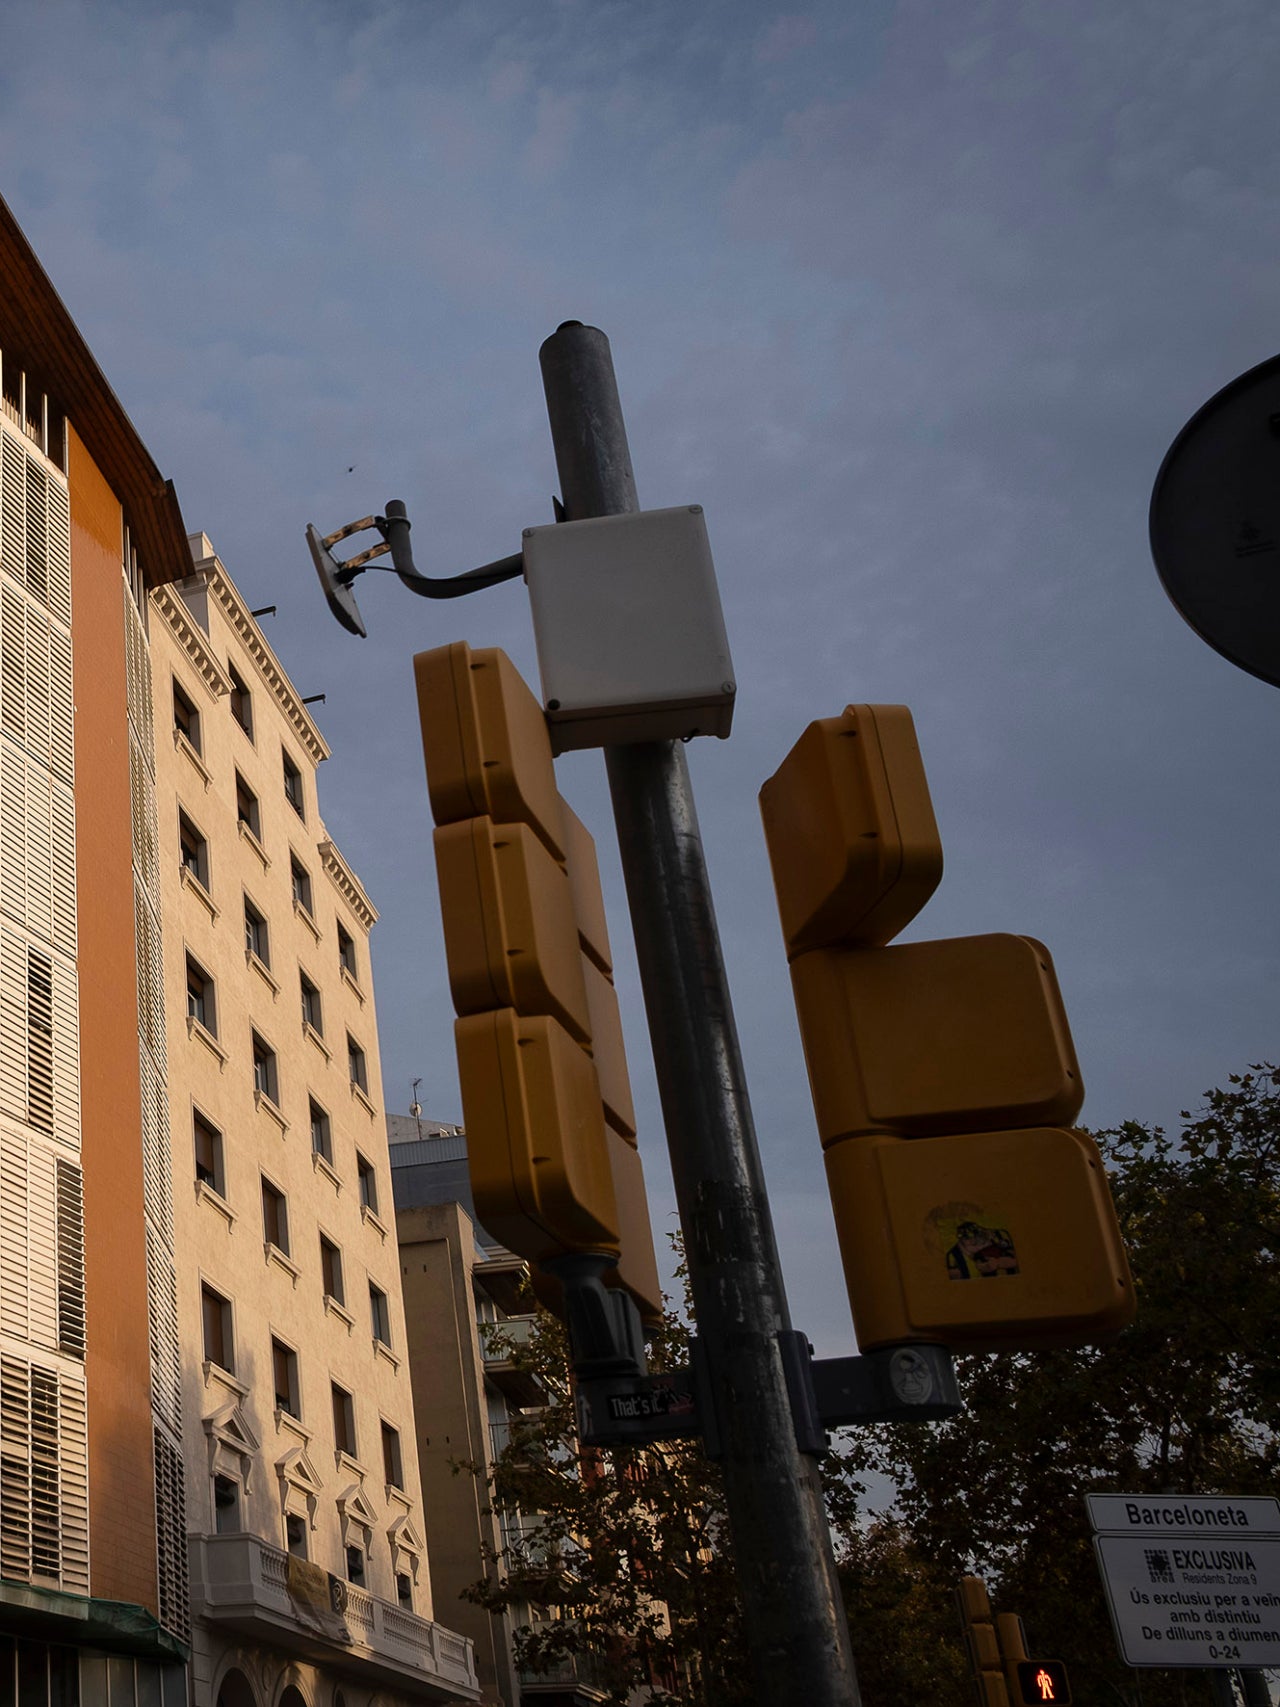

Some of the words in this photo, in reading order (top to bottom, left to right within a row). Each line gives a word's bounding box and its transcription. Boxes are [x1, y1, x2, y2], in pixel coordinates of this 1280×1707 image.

[610, 1395, 650, 1417] That's
[1125, 1503, 1249, 1526] Barceloneta
[1172, 1550, 1257, 1571] EXCLUSIVA
[1182, 1572, 1226, 1584] Residents
[1227, 1573, 1250, 1585] Zona
[1250, 1575, 1257, 1585] 9
[1130, 1586, 1150, 1604] Ús
[1153, 1591, 1211, 1606] exclusiu
[1215, 1595, 1236, 1609] per
[1241, 1595, 1250, 1606] a
[1170, 1609, 1201, 1623] amb
[1204, 1609, 1261, 1624] distintiu
[1141, 1626, 1162, 1640] De
[1166, 1627, 1212, 1641] dilluns
[1216, 1631, 1225, 1641] a
[1208, 1645, 1241, 1659] 0-24
